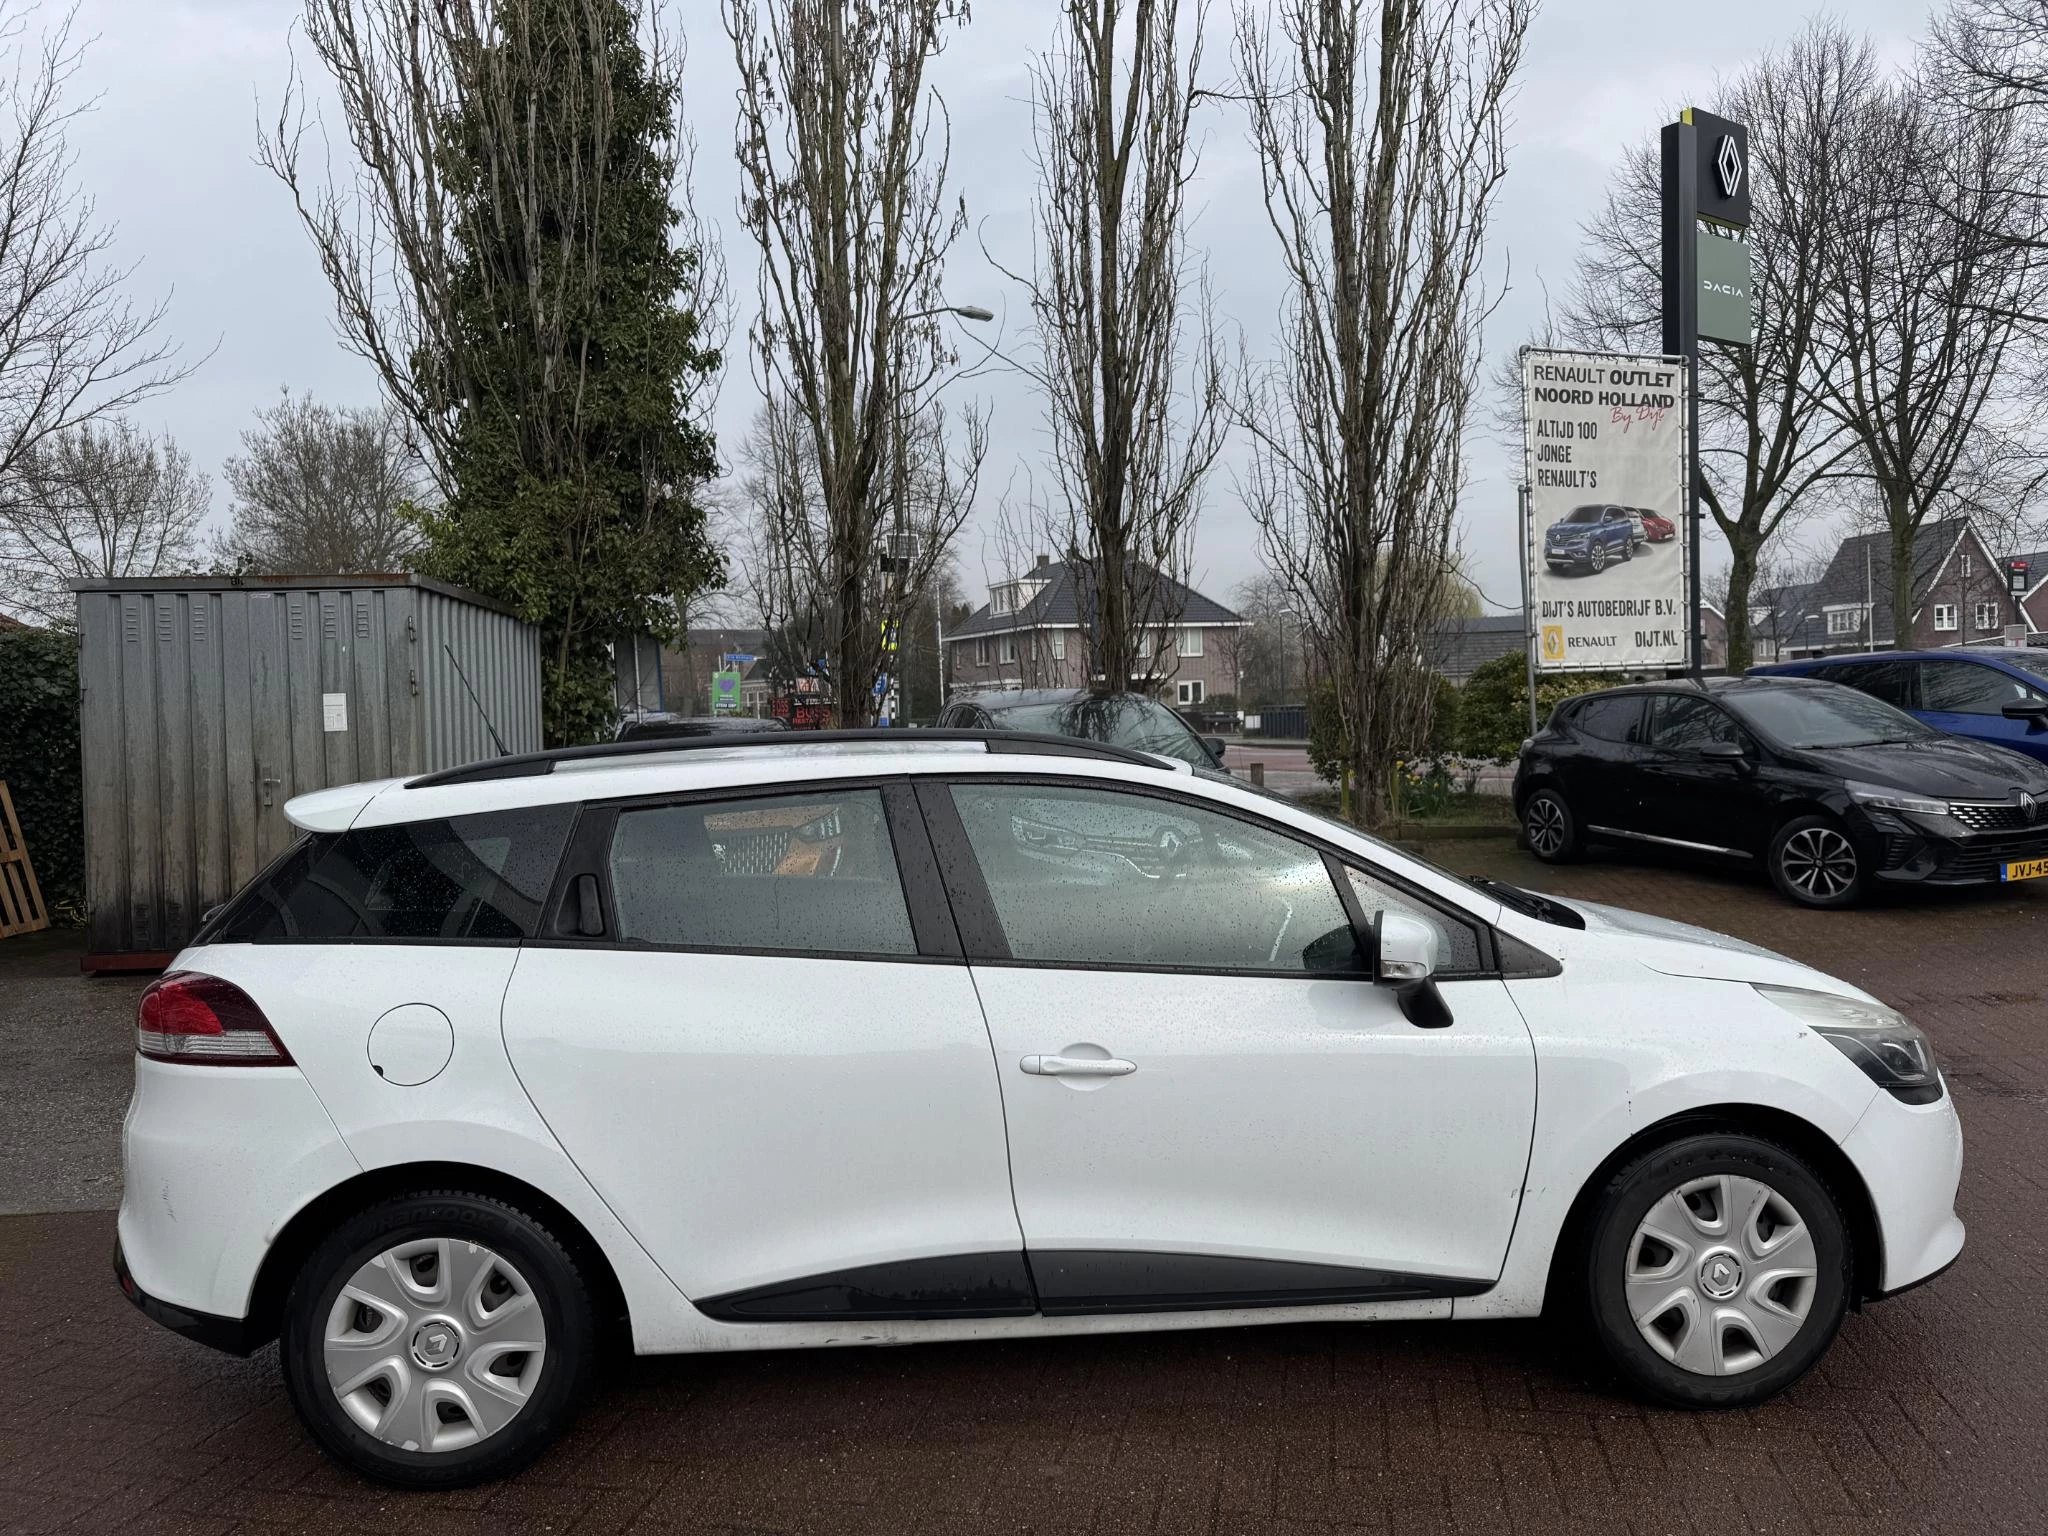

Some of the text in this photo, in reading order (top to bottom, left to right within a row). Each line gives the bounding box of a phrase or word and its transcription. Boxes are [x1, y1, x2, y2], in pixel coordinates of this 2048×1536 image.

[1703, 280, 1744, 298] DACIA
[1534, 365, 1675, 387] RENAULT OUTLET
[1534, 387, 1675, 408] NOORD HOLLAND
[1537, 419, 1598, 440] ALTIJD 100
[1611, 406, 1633, 433] By
[1537, 444, 1572, 463] JONGE
[1537, 468, 1597, 489] RENAULT'S
[1542, 599, 1677, 618] DIJT'S AUTOBEDRIJF B.V.
[1567, 630, 1678, 648] RENAULT DIJT.NL
